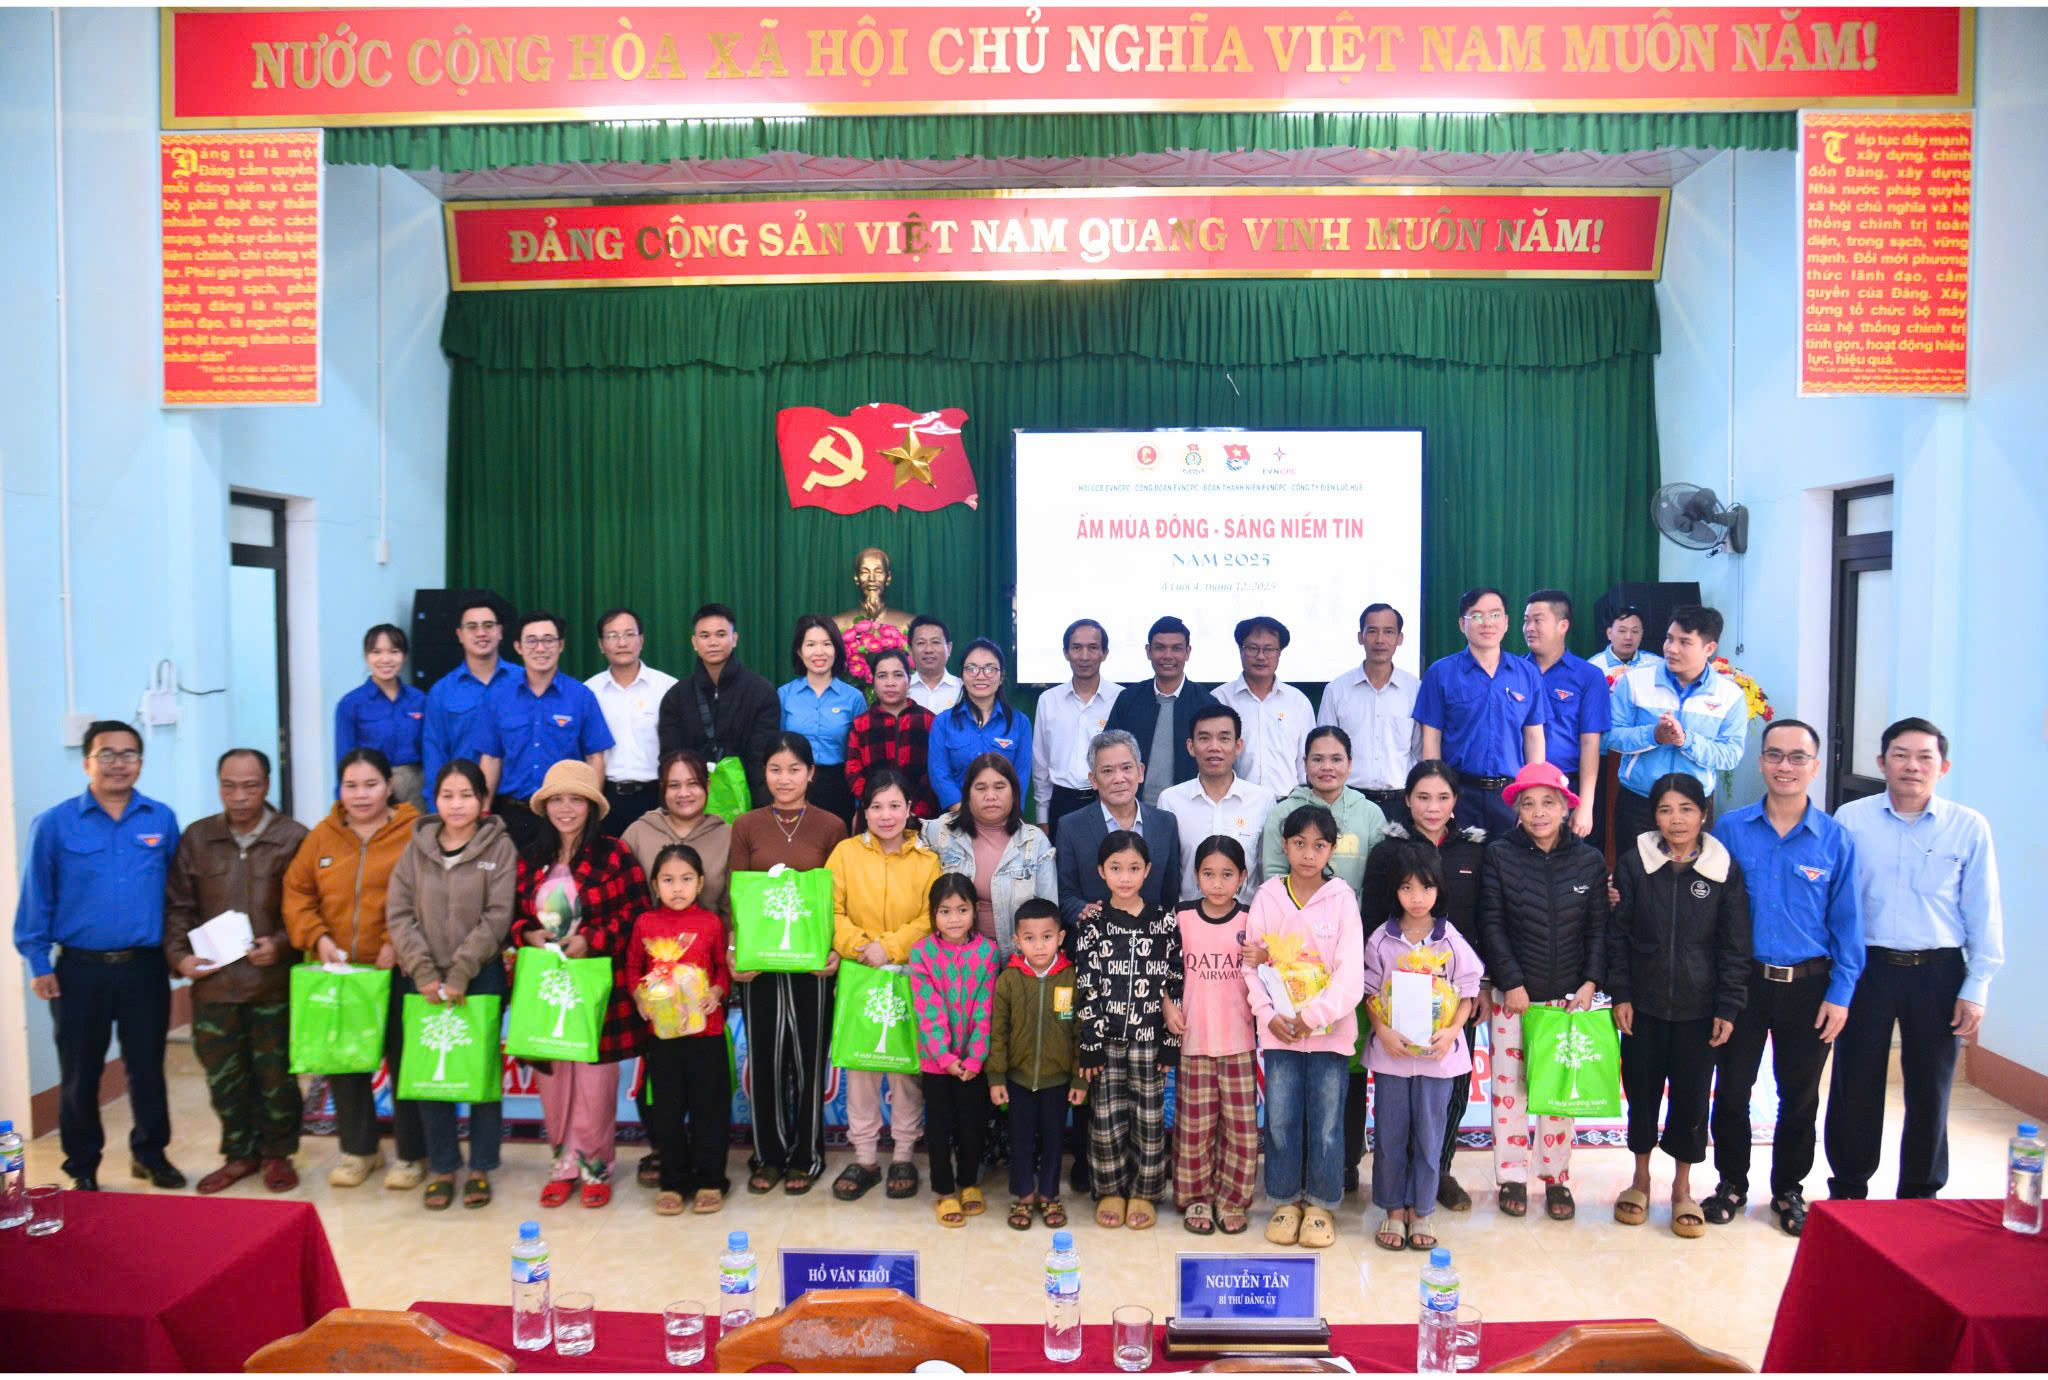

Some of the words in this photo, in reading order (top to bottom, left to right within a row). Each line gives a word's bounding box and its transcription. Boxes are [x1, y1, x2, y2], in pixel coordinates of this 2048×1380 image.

[251, 23, 393, 88] NƯỚC
[407, 23, 554, 97] CỘNG
[567, 15, 688, 80] HÒA
[704, 18, 789, 79] XÃ
[805, 14, 909, 87] HỘI
[927, 6, 1049, 75] CHỦ
[1066, 11, 1254, 73] NGHĨA
[1264, 10, 1404, 84] VIỆT
[1418, 24, 1547, 73] NAM
[1561, 8, 1718, 73] MUÔN
[1731, 8, 1878, 72] NĂM!
[1878, 135, 1901, 147] tục
[1929, 134, 1969, 147] mạnh
[1857, 151, 1882, 162] xây
[1897, 168, 1923, 180] xây
[1931, 167, 1972, 180] dựng
[1808, 183, 1836, 195] Nhà
[1842, 185, 1880, 195] nước
[1886, 184, 1922, 197] pháp
[1829, 201, 1851, 213] hội
[1887, 202, 1927, 215] nghĩa
[1931, 202, 1948, 213] và
[1807, 216, 1851, 231] thống
[1859, 219, 1902, 230] chính
[1910, 219, 1928, 232] trị
[1936, 219, 1970, 230] toàn
[509, 217, 624, 263] ĐẢNG
[636, 215, 748, 268] CỘNG
[759, 209, 845, 257] SẢN
[855, 212, 959, 262] VIỆT
[971, 218, 1069, 253] NAM
[1079, 217, 1228, 263] QUANG
[1242, 218, 1352, 252] VINH
[1365, 206, 1485, 252] MUÔN
[1495, 207, 1605, 253] NĂM!
[1847, 236, 1885, 249] trong
[1933, 237, 1970, 250] vững
[1881, 253, 1909, 264] mới
[1912, 253, 1969, 267] phương
[1807, 269, 1843, 281] thức
[1852, 270, 1885, 281] lãnh
[1858, 287, 1884, 299] của
[1941, 287, 1968, 301] Xây
[1806, 304, 1843, 317] dựng
[1871, 304, 1906, 316] chức
[1912, 305, 1931, 318] bộ
[1937, 306, 1967, 319] máy
[1806, 321, 1832, 332] của
[1837, 322, 1855, 334] hệ
[1860, 319, 1901, 335] thống
[1906, 322, 1945, 334] chính
[1951, 323, 1967, 336] trị
[1866, 340, 1897, 352] hoạt
[1898, 339, 1934, 353] động
[1935, 340, 1966, 352] hiệu
[1836, 353, 1866, 367] hiệu
[1155, 513, 1209, 539] ĐÔNG
[1332, 518, 1364, 539] TIN
[1223, 553, 1270, 567] 2025
[829, 1266, 856, 1282] VĂN
[858, 1265, 891, 1283] KHỞI
[1205, 1269, 1260, 1288] NGUYỄN
[1263, 1271, 1290, 1288] TÂN
[1228, 1294, 1244, 1305] THƯ
[1244, 1292, 1265, 1305] ĐẢNG
